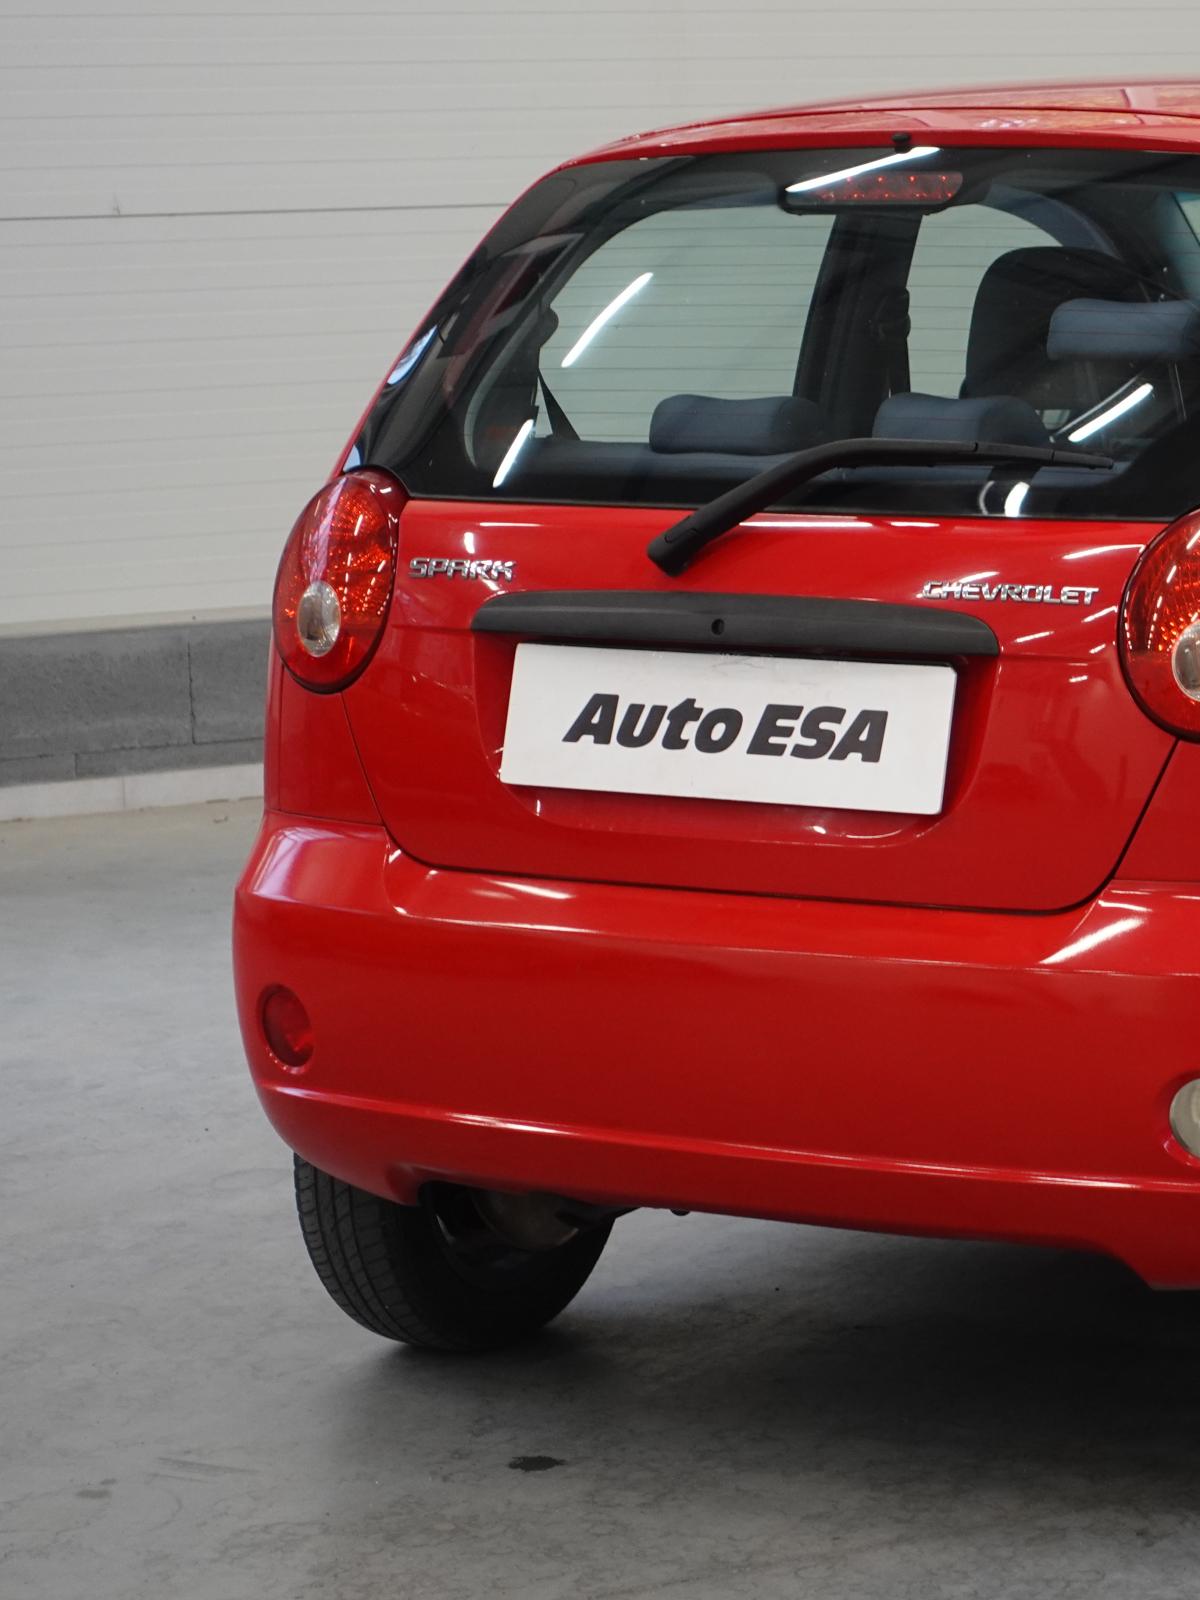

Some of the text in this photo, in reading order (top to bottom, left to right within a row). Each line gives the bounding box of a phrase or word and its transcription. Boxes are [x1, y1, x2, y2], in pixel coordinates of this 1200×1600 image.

[409, 557, 515, 581] SPARK
[922, 581, 1099, 605] CHEVROLET
[562, 693, 889, 763] Auto ESA
